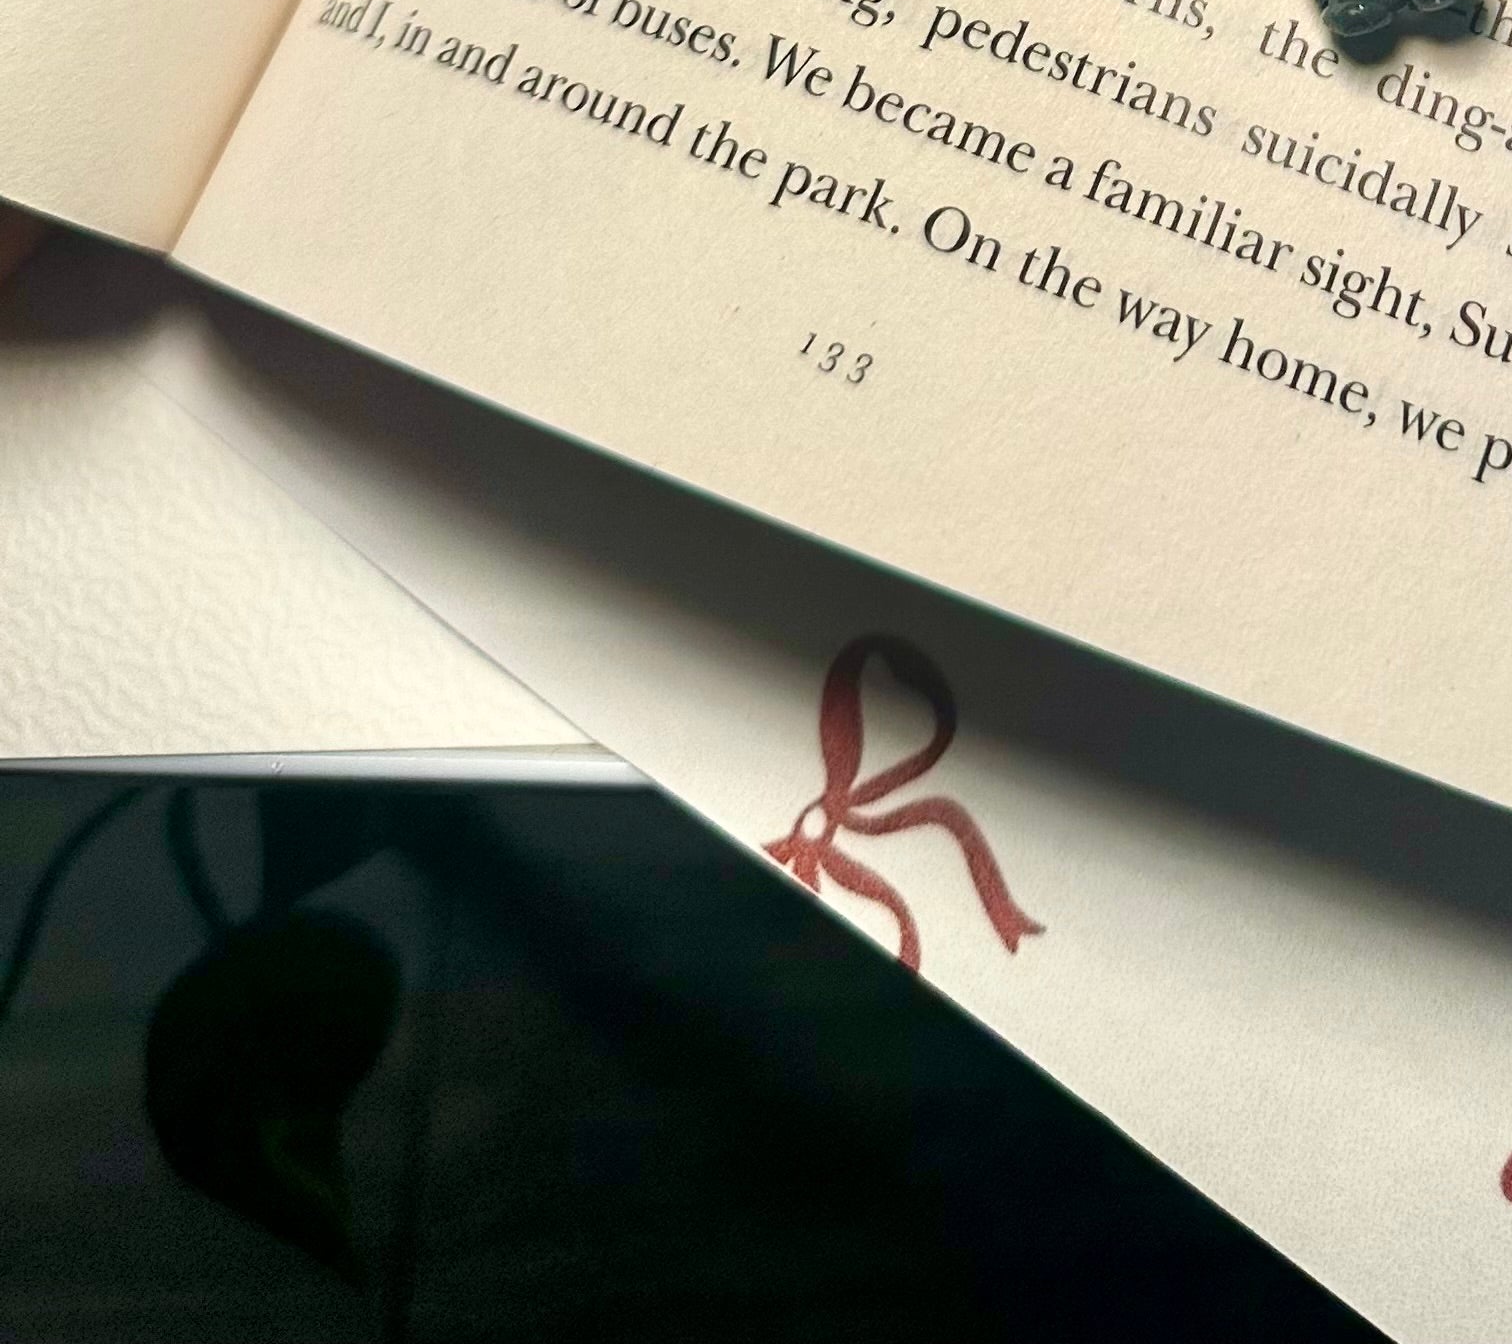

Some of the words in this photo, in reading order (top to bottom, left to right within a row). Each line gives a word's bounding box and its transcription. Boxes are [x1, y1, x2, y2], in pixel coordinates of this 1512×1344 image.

[920, 6, 1216, 136] pedestrians
[1241, 125, 1482, 250] suicidally
[1259, 18, 1341, 80] the
[361, 0, 388, 50] I,
[392, 10, 433, 58] in
[436, 38, 518, 84] and
[517, 67, 684, 146] around
[690, 121, 767, 178] the
[769, 162, 898, 234] park.
[924, 207, 1001, 271] On
[1019, 246, 1101, 308] the
[1120, 289, 1212, 362] way
[1219, 318, 1375, 427] home,
[1402, 401, 1464, 451] we
[765, 34, 832, 96] We
[842, 65, 1035, 173] became
[1045, 157, 1073, 190] a
[1084, 160, 1294, 271] familiar
[1300, 249, 1431, 338] sight,
[800, 333, 873, 385] 133
